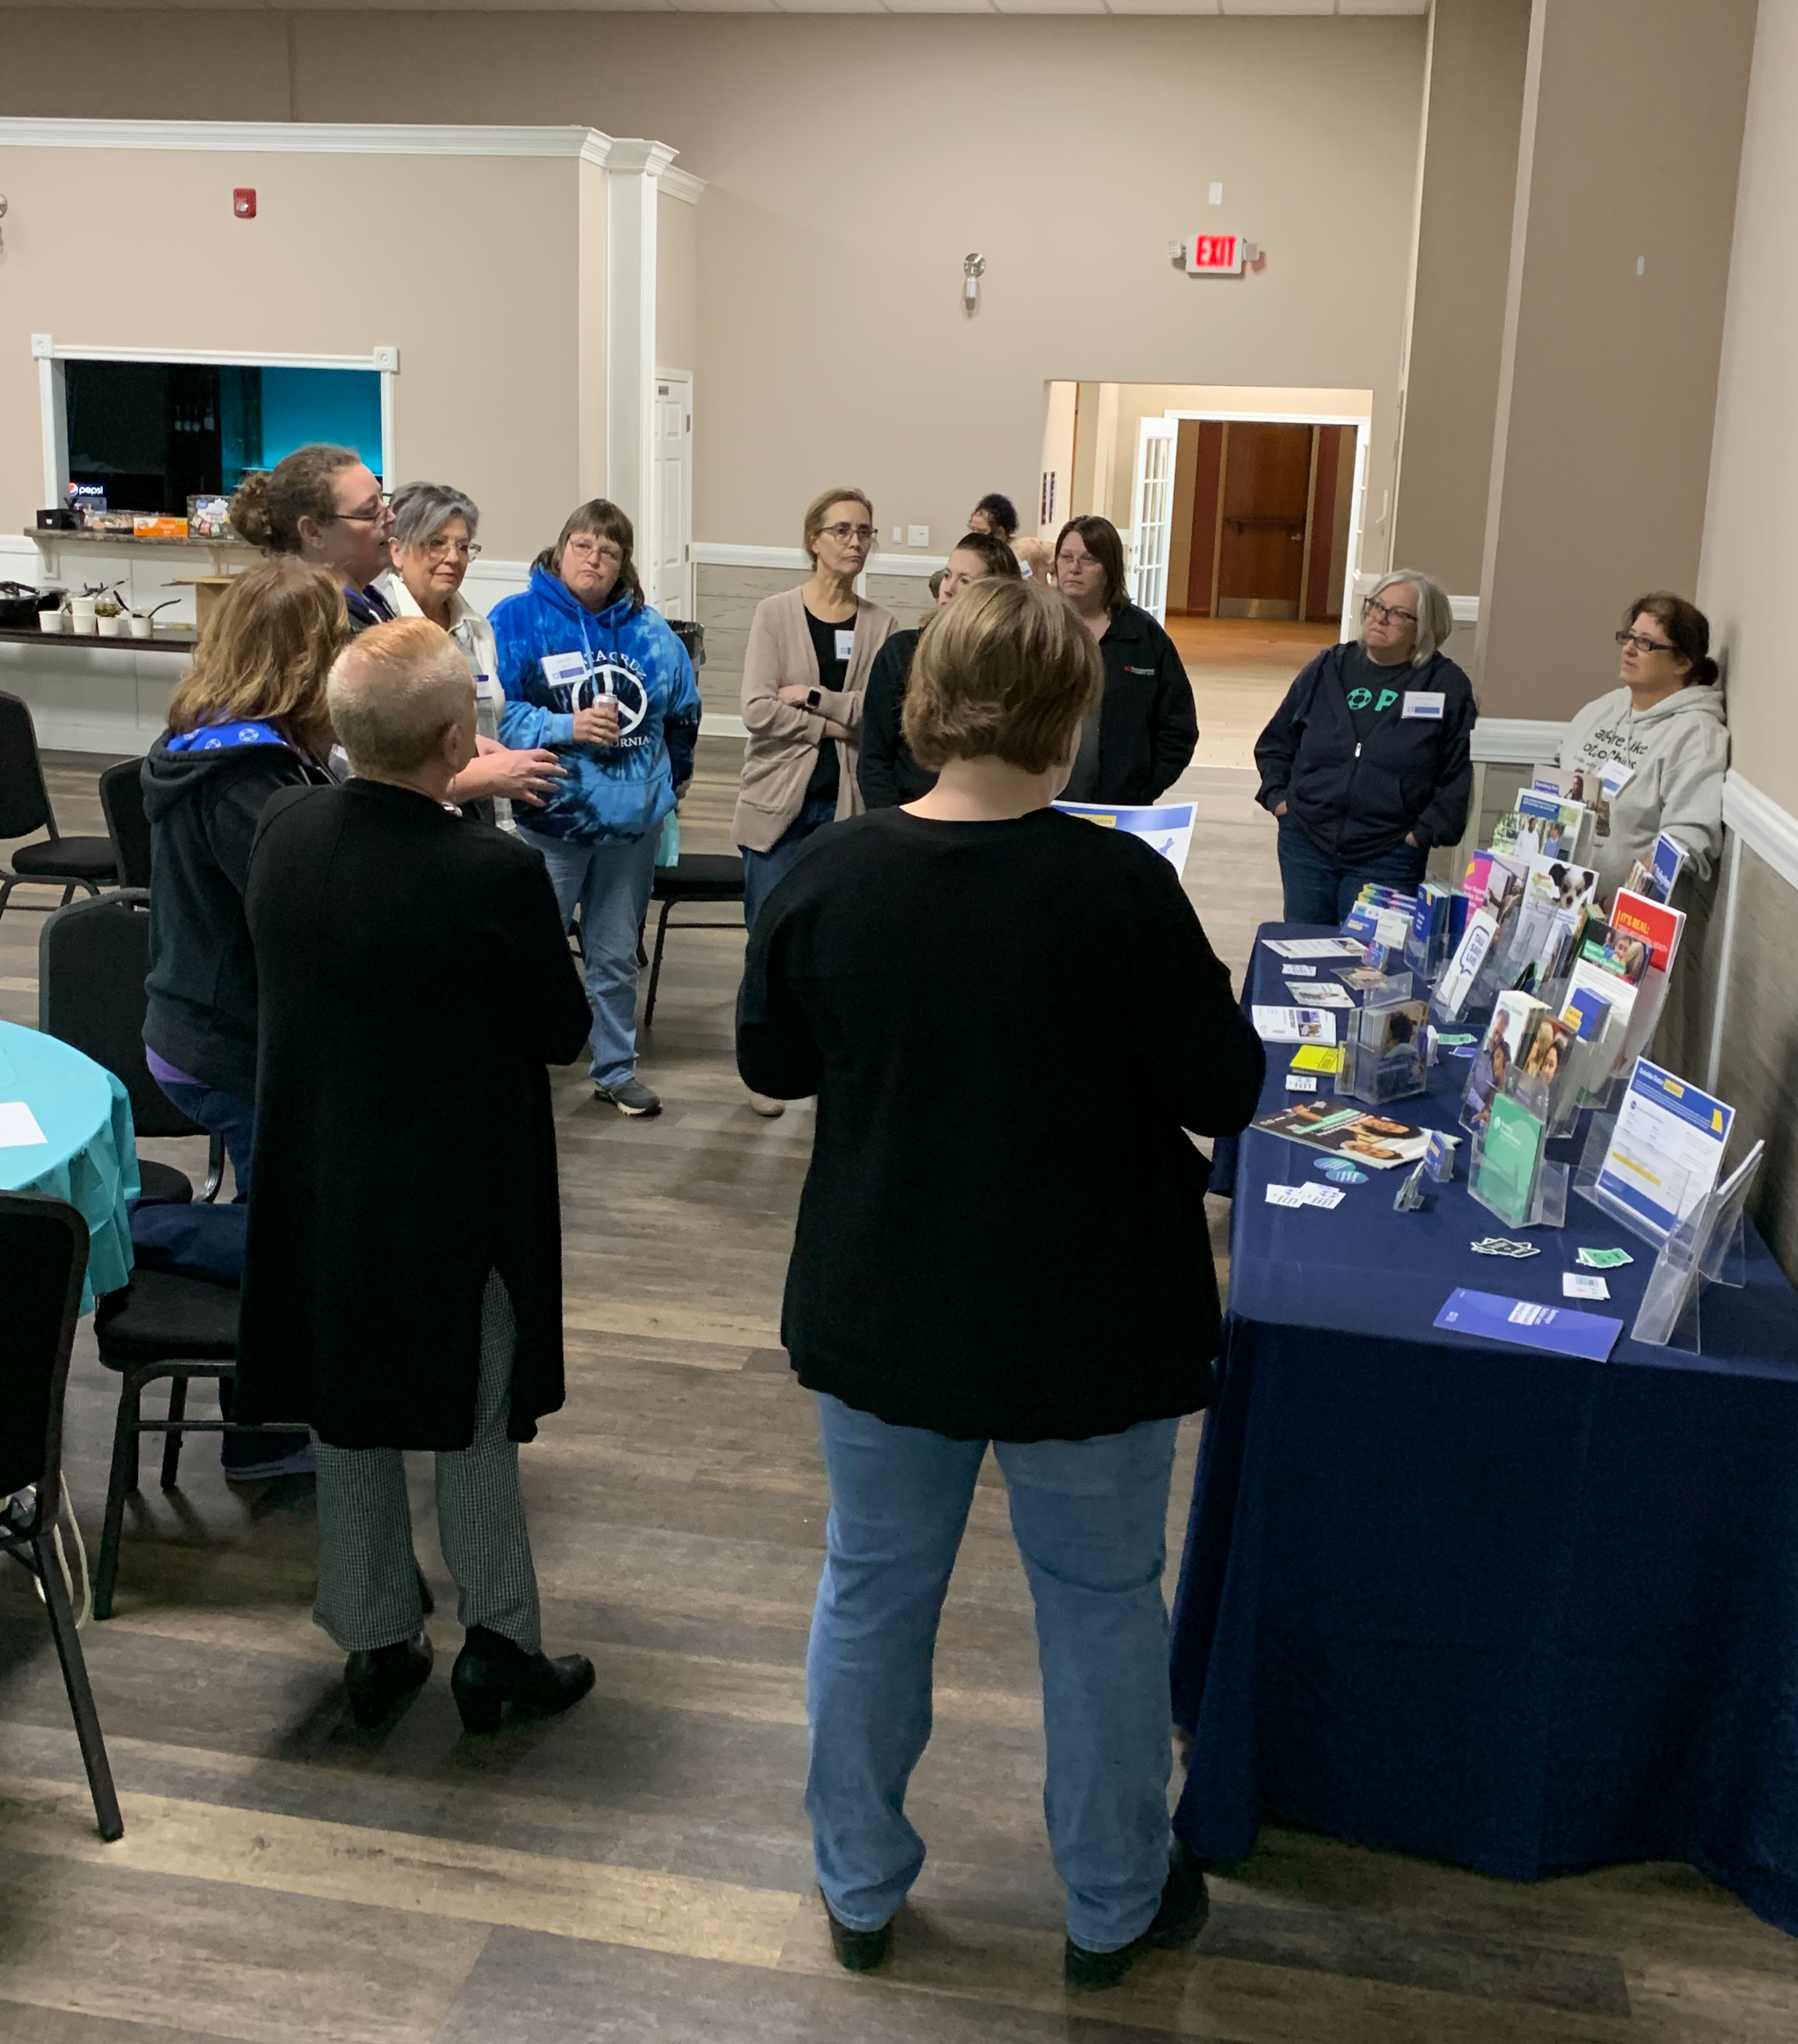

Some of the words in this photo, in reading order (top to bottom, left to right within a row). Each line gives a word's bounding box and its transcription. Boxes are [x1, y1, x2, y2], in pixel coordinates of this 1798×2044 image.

[1196, 235, 1236, 268] EXIT
[78, 486, 103, 495] pepsi
[1347, 687, 1398, 711] OP
